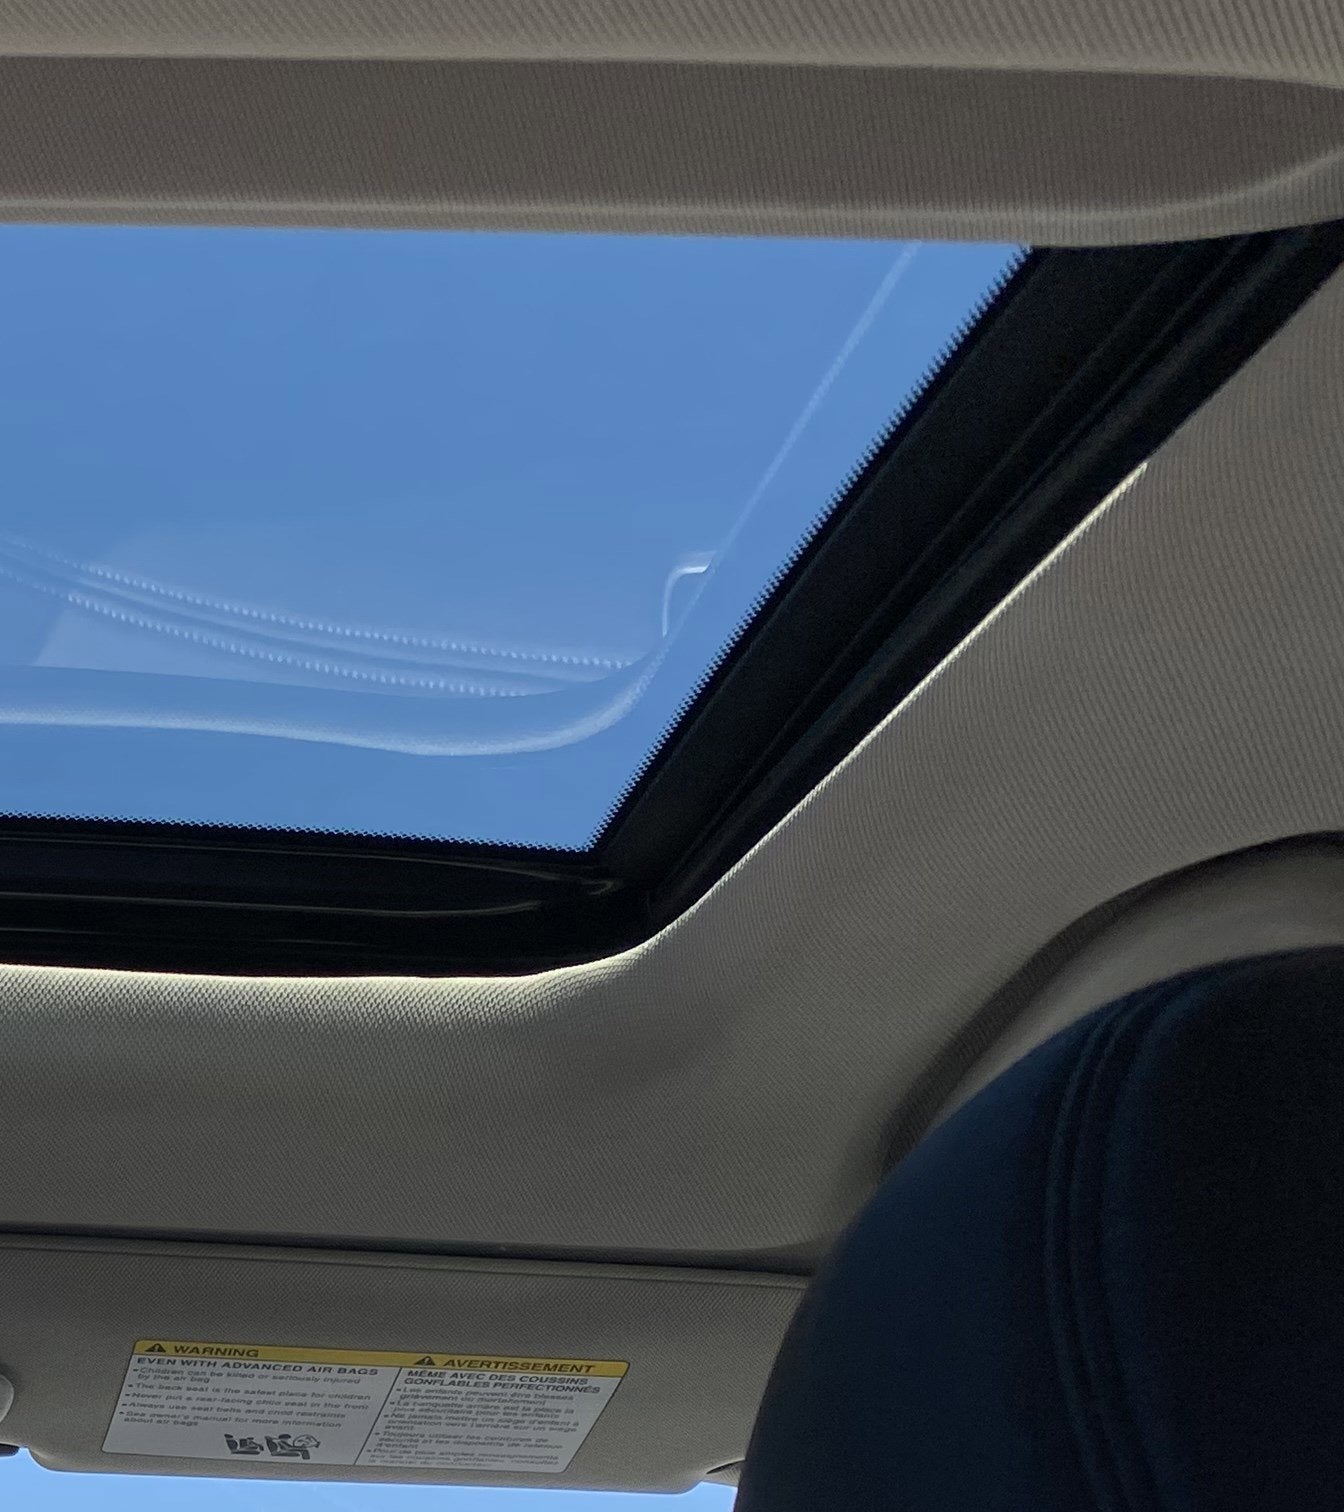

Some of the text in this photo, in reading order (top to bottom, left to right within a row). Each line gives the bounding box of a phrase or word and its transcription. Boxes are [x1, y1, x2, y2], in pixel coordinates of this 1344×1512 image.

[174, 1346, 259, 1357] WARNING
[181, 1359, 217, 1367] WITH
[221, 1362, 302, 1372] ADVANCED
[442, 1359, 595, 1373] AVERTISSEMENT
[450, 1372, 486, 1380] AVEC
[519, 1376, 588, 1385] COUSSINS
